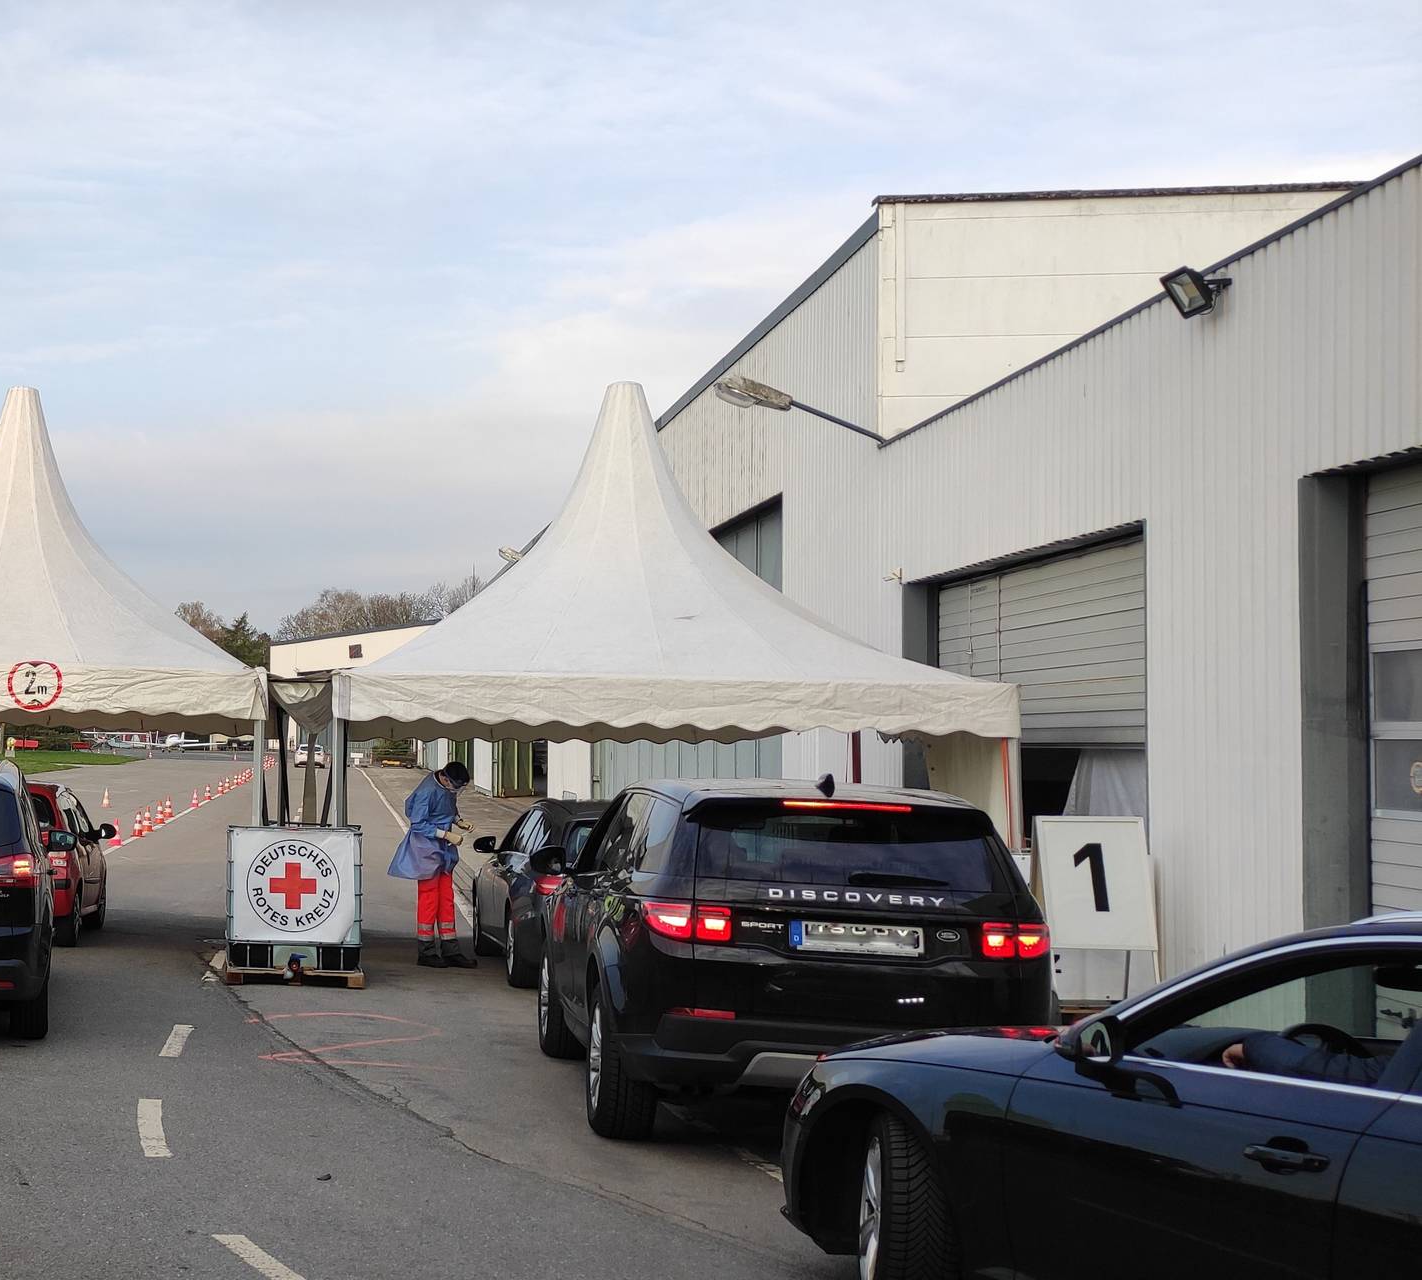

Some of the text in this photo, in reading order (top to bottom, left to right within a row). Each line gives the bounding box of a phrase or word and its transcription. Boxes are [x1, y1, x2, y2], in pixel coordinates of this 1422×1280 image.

[254, 845, 332, 878] DEUTSCHES
[1073, 843, 1110, 912] 1
[252, 887, 335, 927] ROTES KREUZ
[768, 888, 945, 907] DISCOVERY
[741, 921, 785, 930] SPORT
